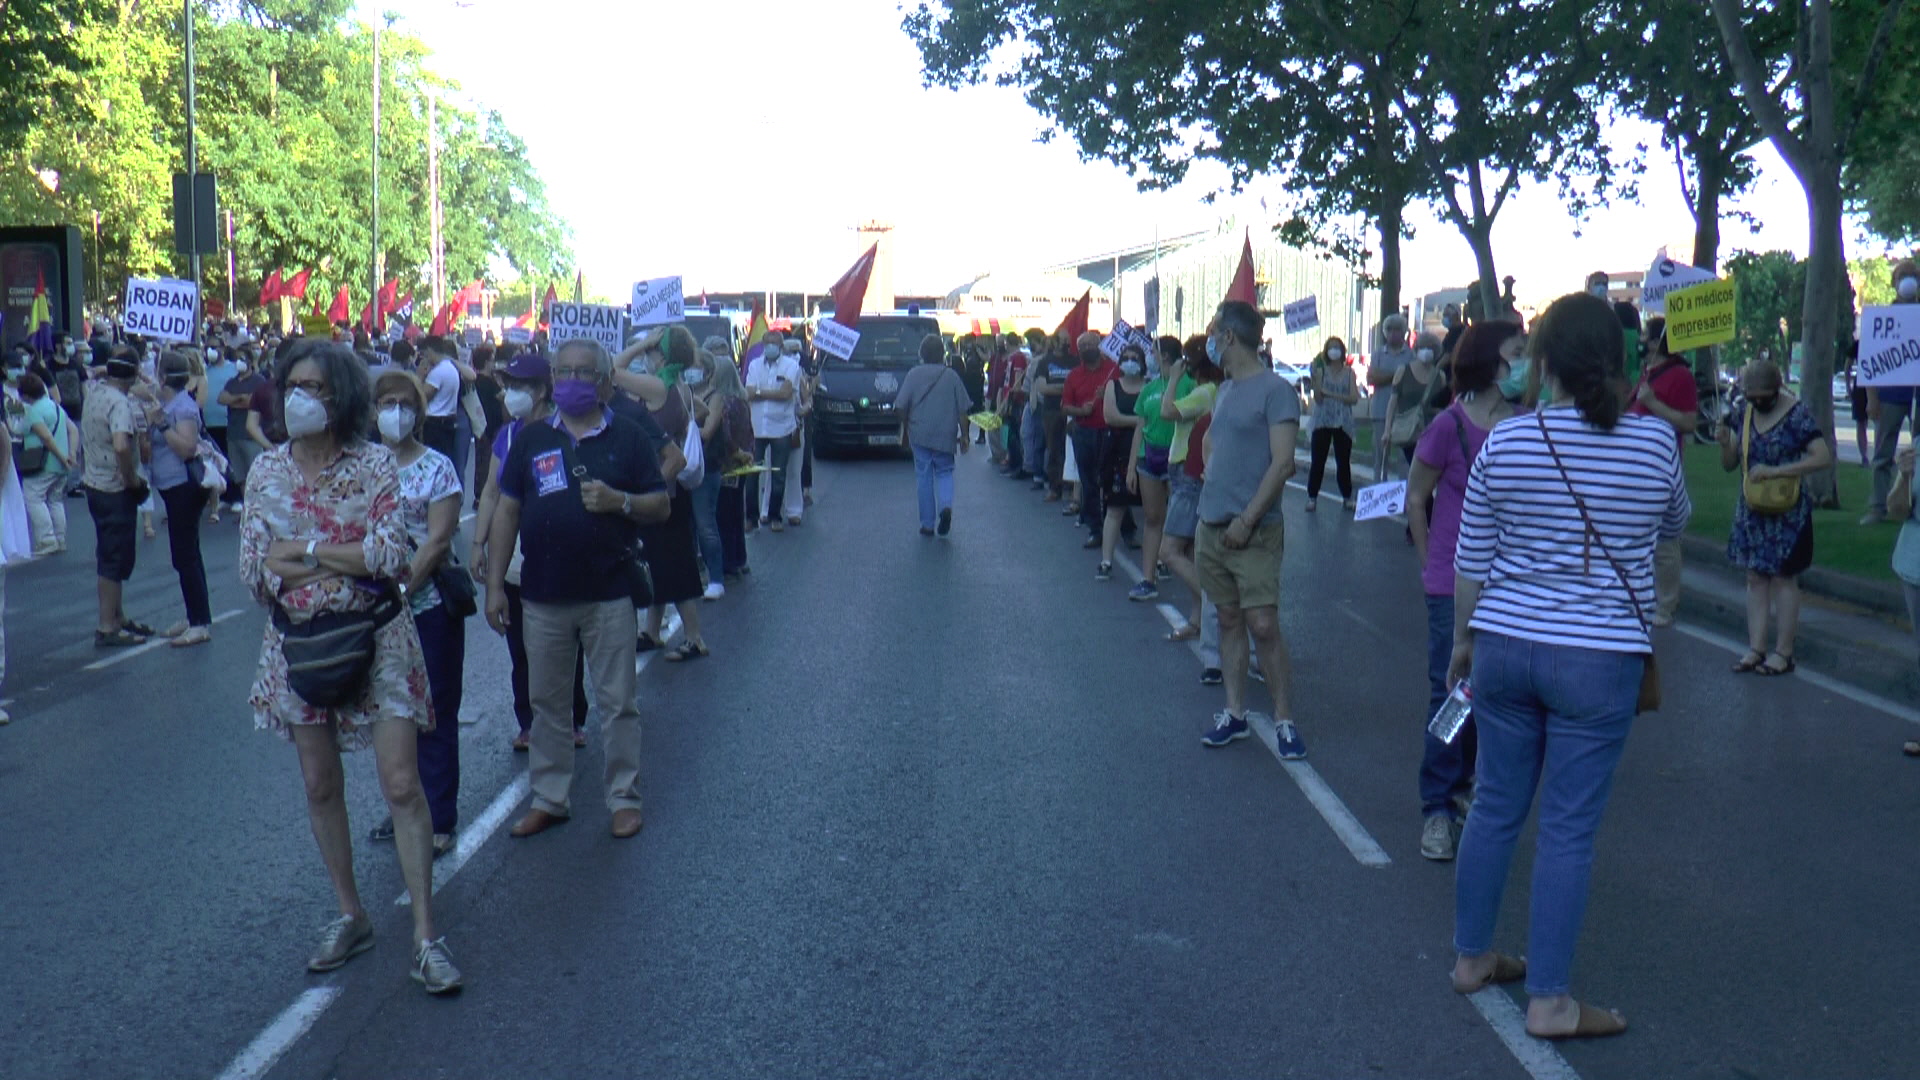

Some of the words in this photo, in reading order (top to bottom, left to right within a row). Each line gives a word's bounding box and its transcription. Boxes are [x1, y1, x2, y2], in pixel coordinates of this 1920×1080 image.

[1669, 296, 1684, 313] NO
[1687, 299, 1693, 310] a
[1695, 289, 1734, 308] médicos
[126, 311, 191, 337] SALUD!
[551, 303, 619, 330] ROBAN
[1672, 312, 1733, 337] empresarios
[552, 327, 568, 339] TU
[1861, 339, 1920, 380] SANIDAD
